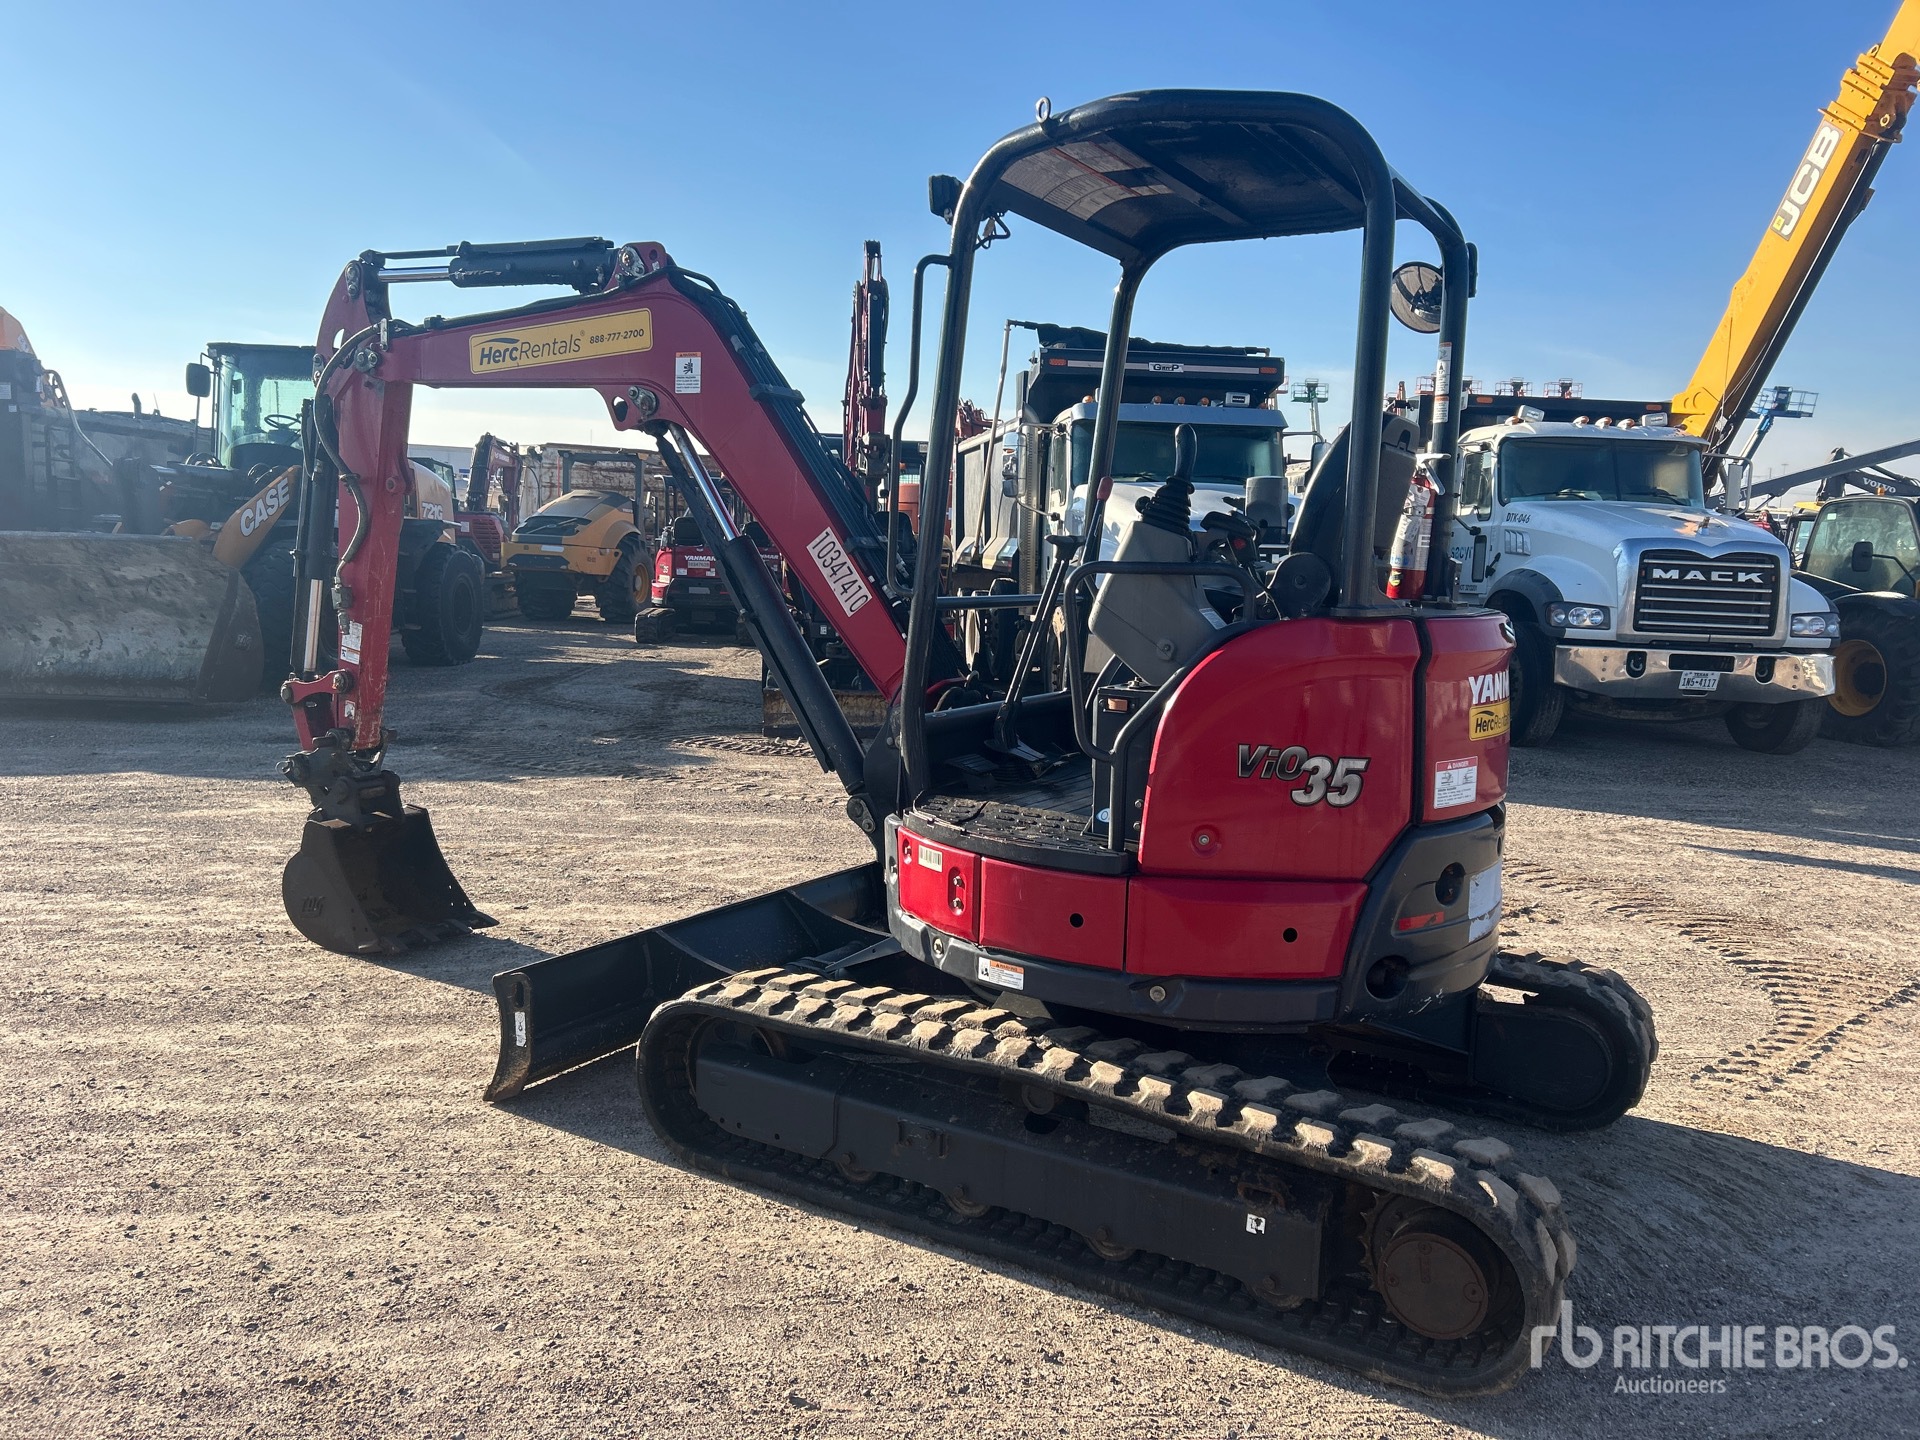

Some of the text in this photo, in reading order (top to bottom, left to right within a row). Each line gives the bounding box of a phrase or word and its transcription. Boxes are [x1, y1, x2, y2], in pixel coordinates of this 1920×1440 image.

[1780, 126, 1840, 236] JCB
[589, 328, 645, 345] 888-777-2700
[240, 476, 290, 537] CASE
[421, 502, 443, 520] 721G
[812, 531, 869, 613] 10347410
[1652, 568, 1764, 584] MACK
